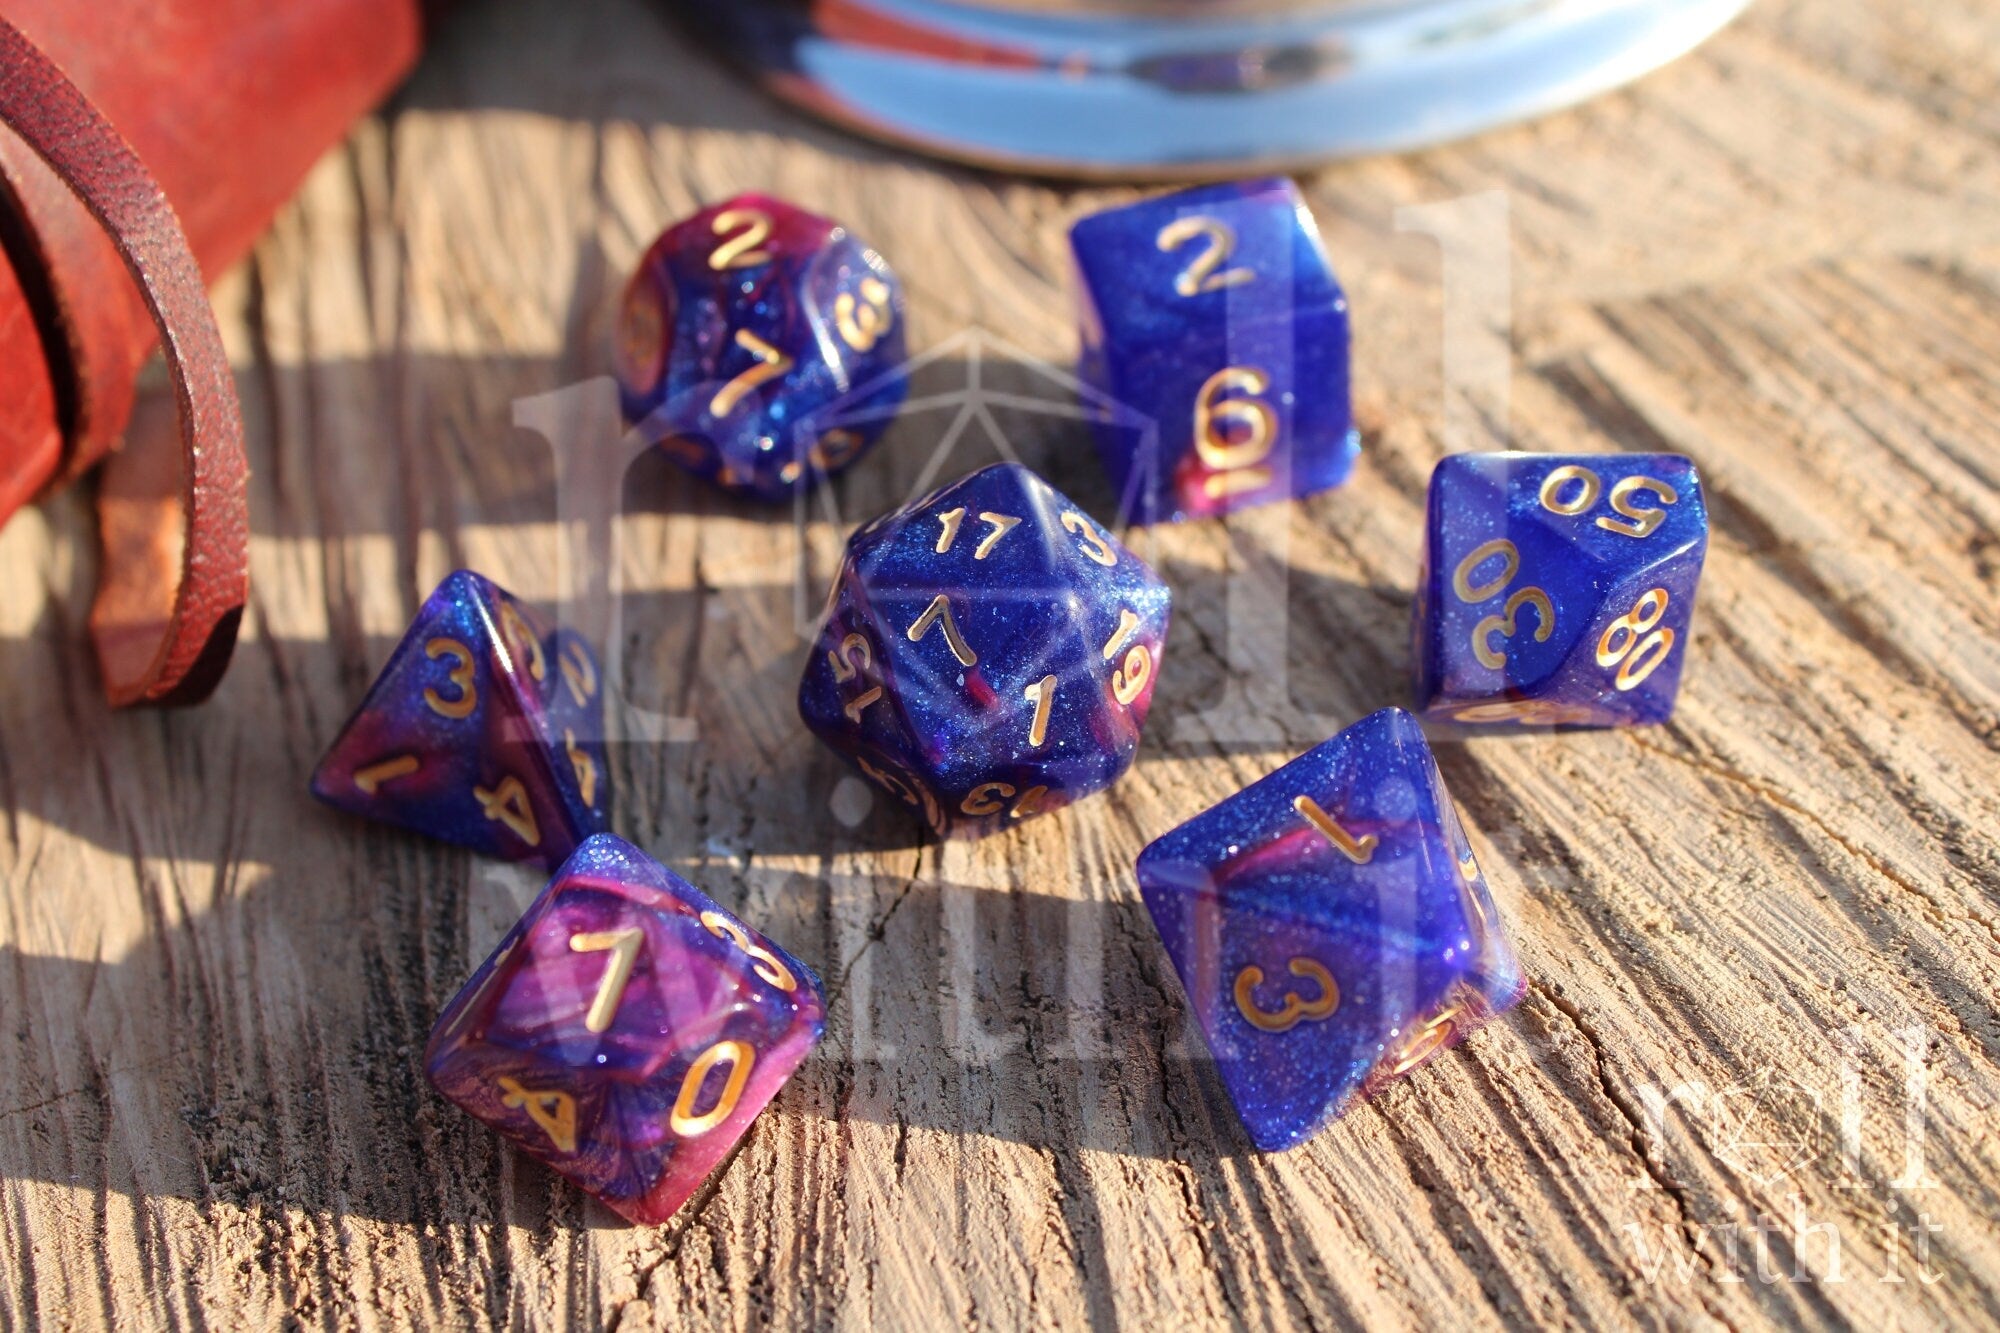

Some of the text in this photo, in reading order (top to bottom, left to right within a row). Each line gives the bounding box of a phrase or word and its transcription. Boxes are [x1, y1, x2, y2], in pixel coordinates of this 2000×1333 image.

[708, 209, 771, 271] 2
[1156, 214, 1257, 297] 2
[710, 328, 794, 418] 7
[1193, 366, 1279, 471] 6
[933, 506, 1023, 561] 17
[1539, 464, 1679, 539] 50
[1060, 511, 1118, 568] 3
[907, 594, 977, 668] 7
[1452, 538, 1556, 671] 30
[423, 636, 478, 720] 3
[1024, 674, 1059, 748] 1
[353, 754, 420, 795] 1
[473, 775, 542, 847] 4
[1293, 795, 1380, 865] 1
[569, 926, 645, 1034] 7
[1233, 956, 1341, 1033] 3
[670, 1039, 756, 1138] 0
